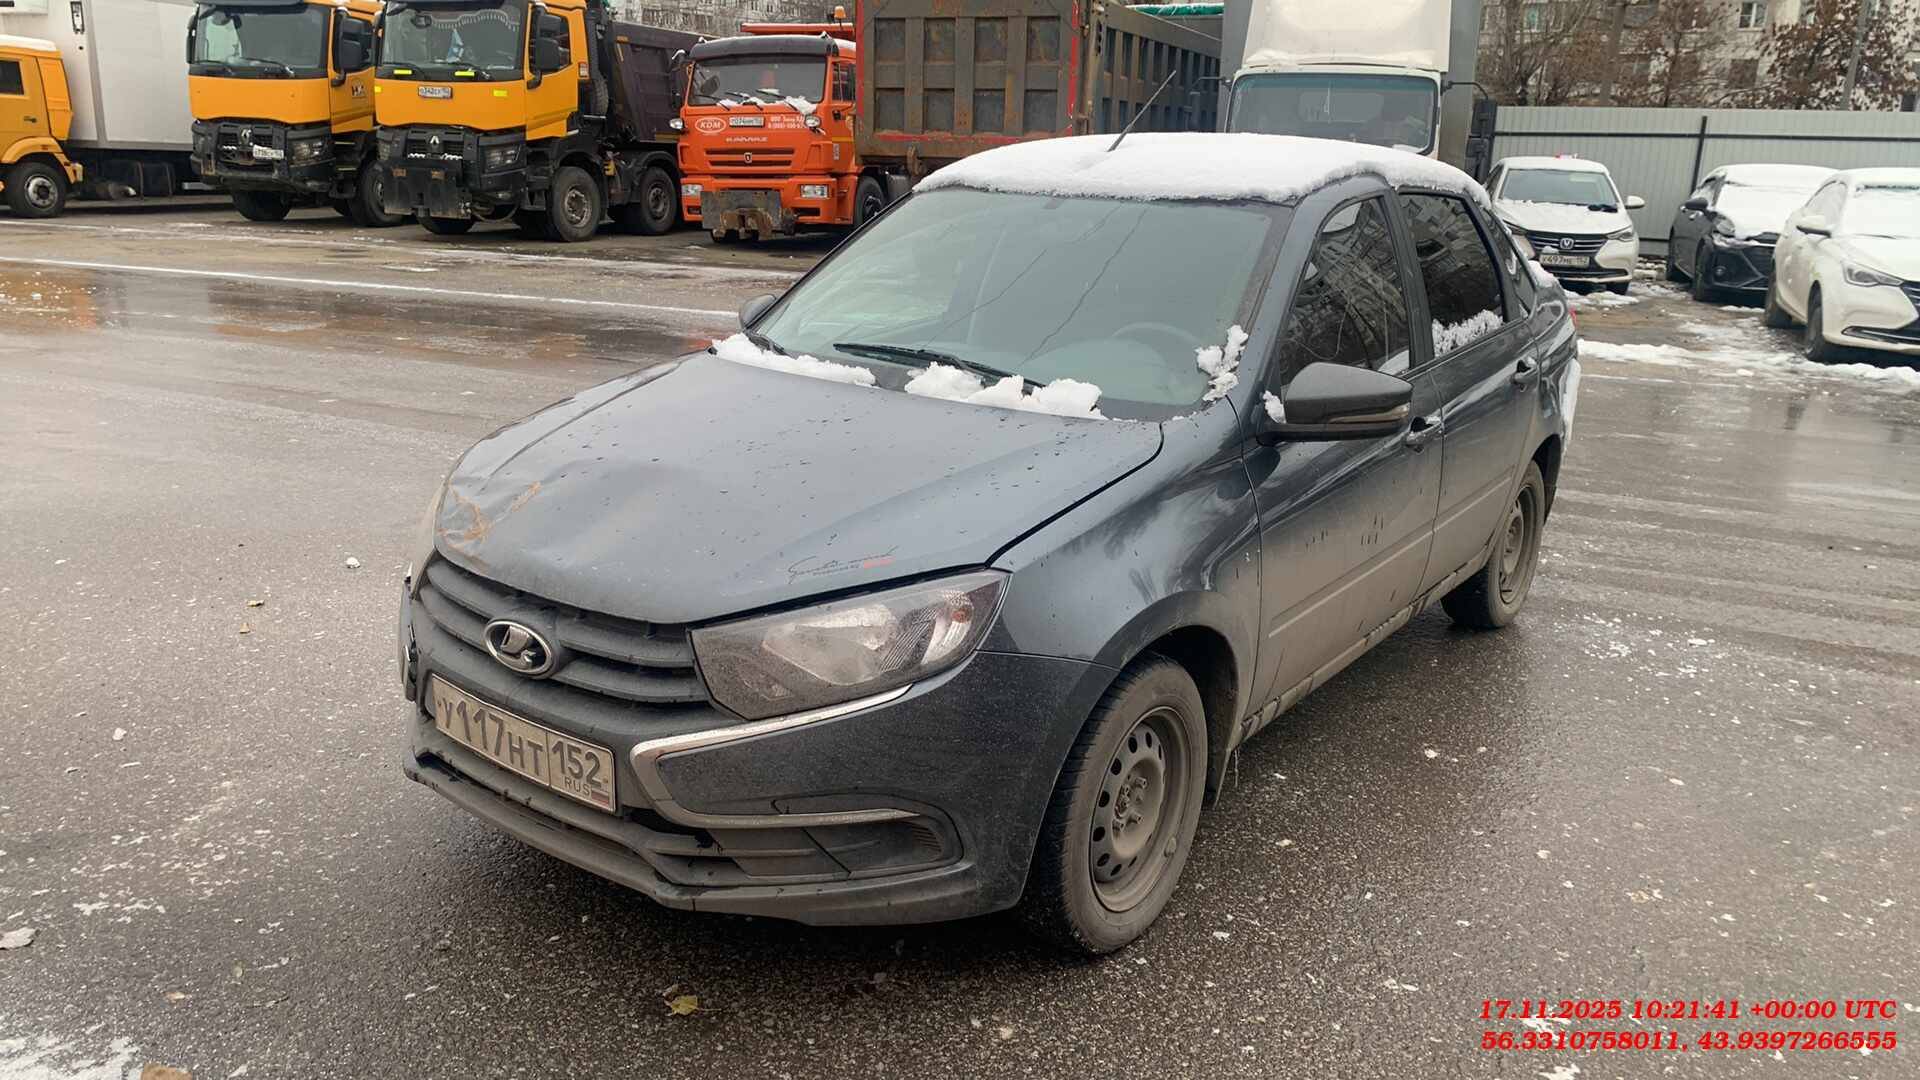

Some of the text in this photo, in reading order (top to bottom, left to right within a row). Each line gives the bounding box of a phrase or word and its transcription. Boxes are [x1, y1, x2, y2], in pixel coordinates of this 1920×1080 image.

[442, 697, 602, 789] У117НТ 152
[564, 776, 590, 796] RUS
